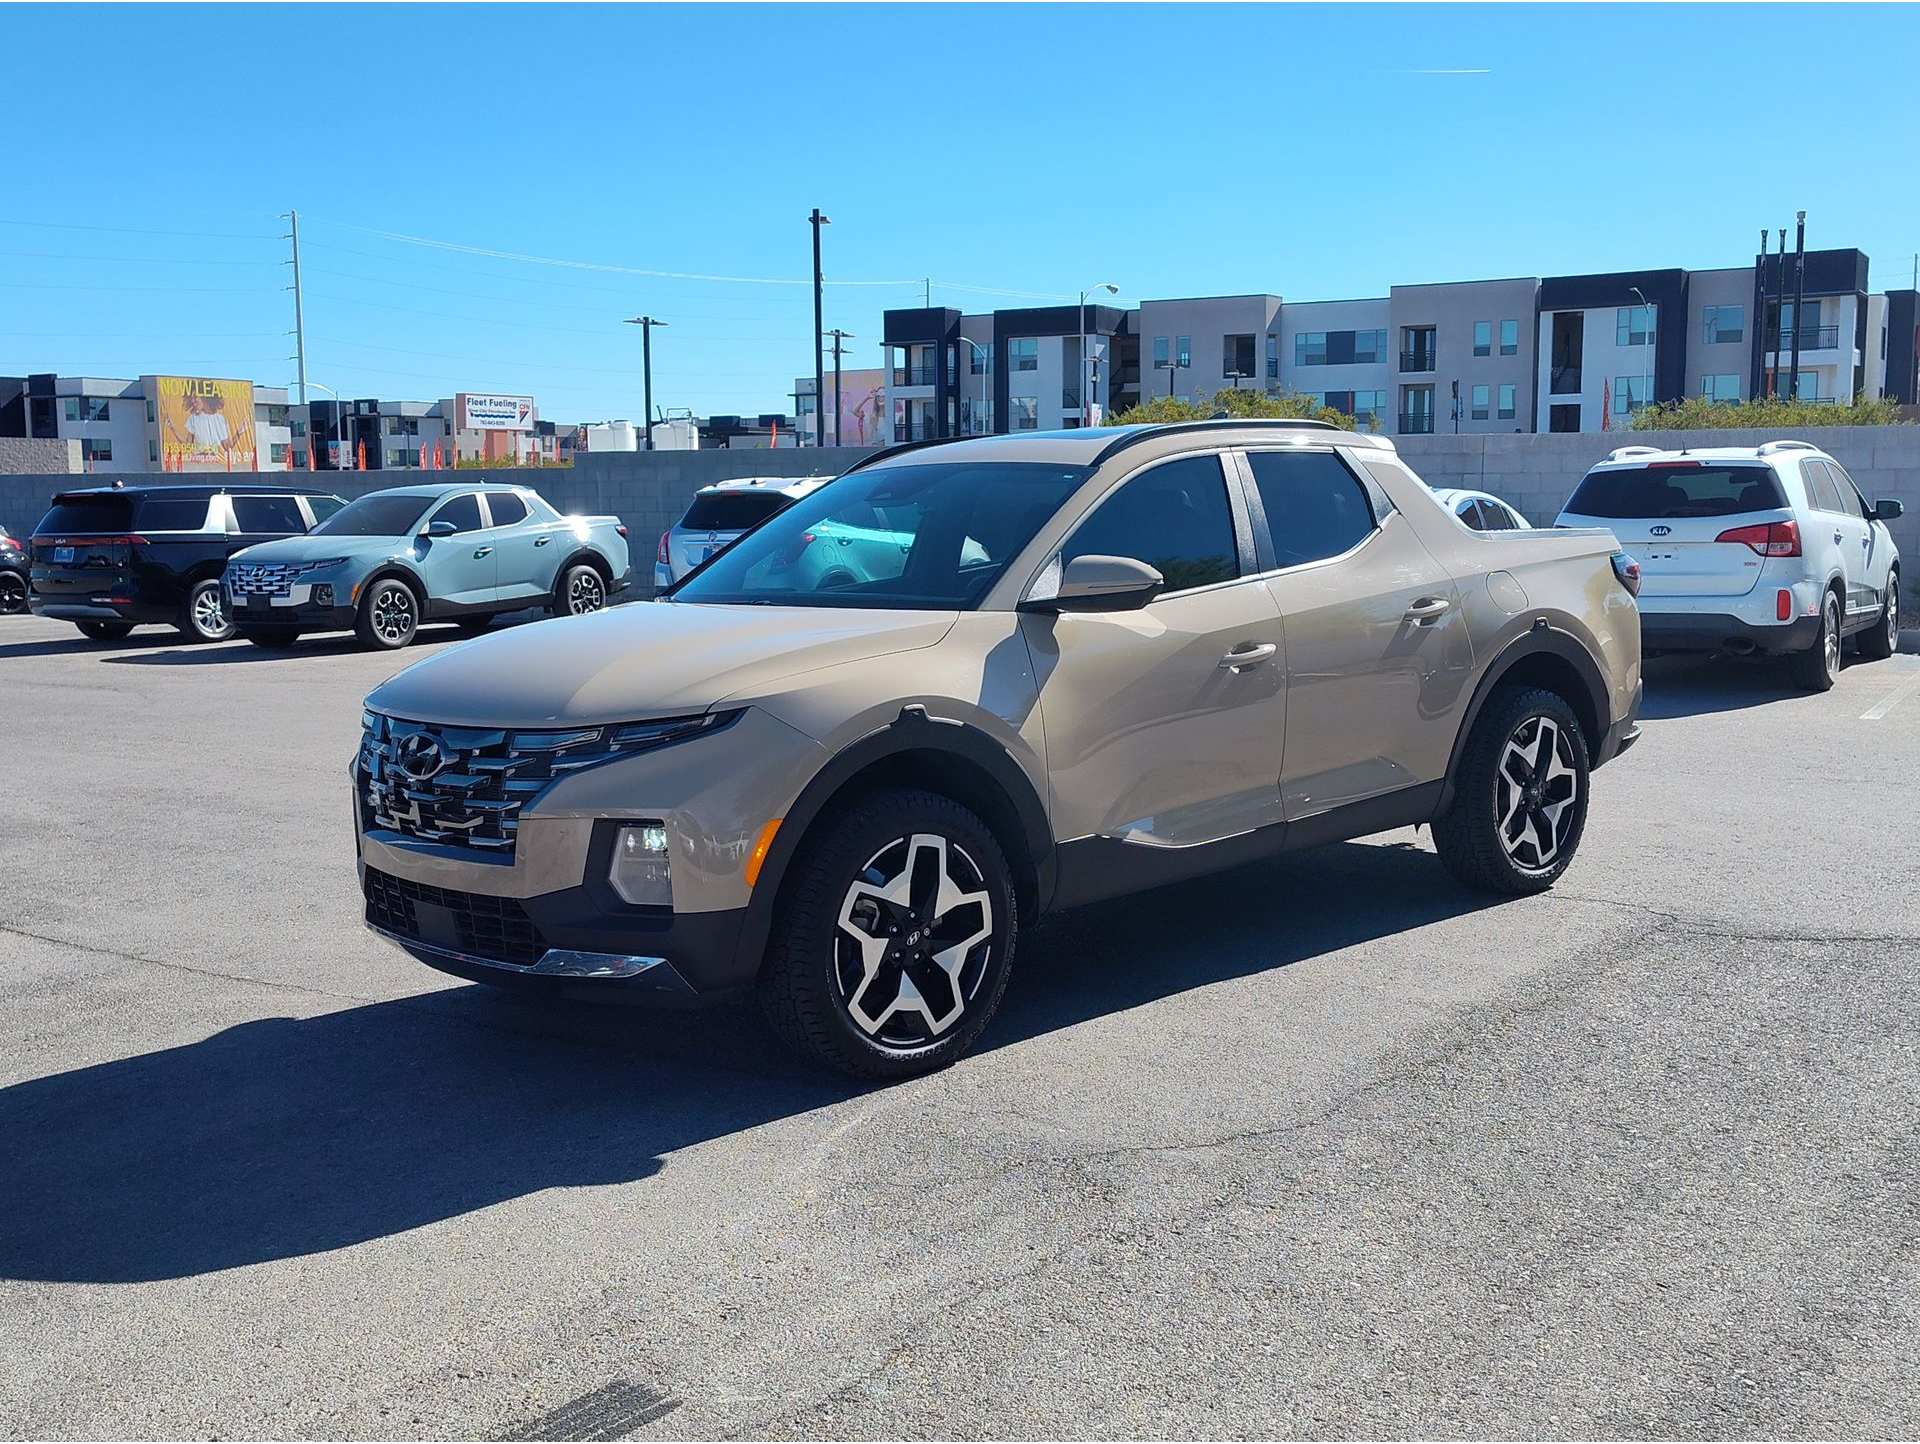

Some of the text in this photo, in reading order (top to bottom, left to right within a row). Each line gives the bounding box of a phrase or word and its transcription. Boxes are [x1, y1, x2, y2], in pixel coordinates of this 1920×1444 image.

[160, 378, 249, 398] NOW LEASING
[467, 397, 517, 409] Fleet Fueling
[1652, 527, 1668, 535] KIA
